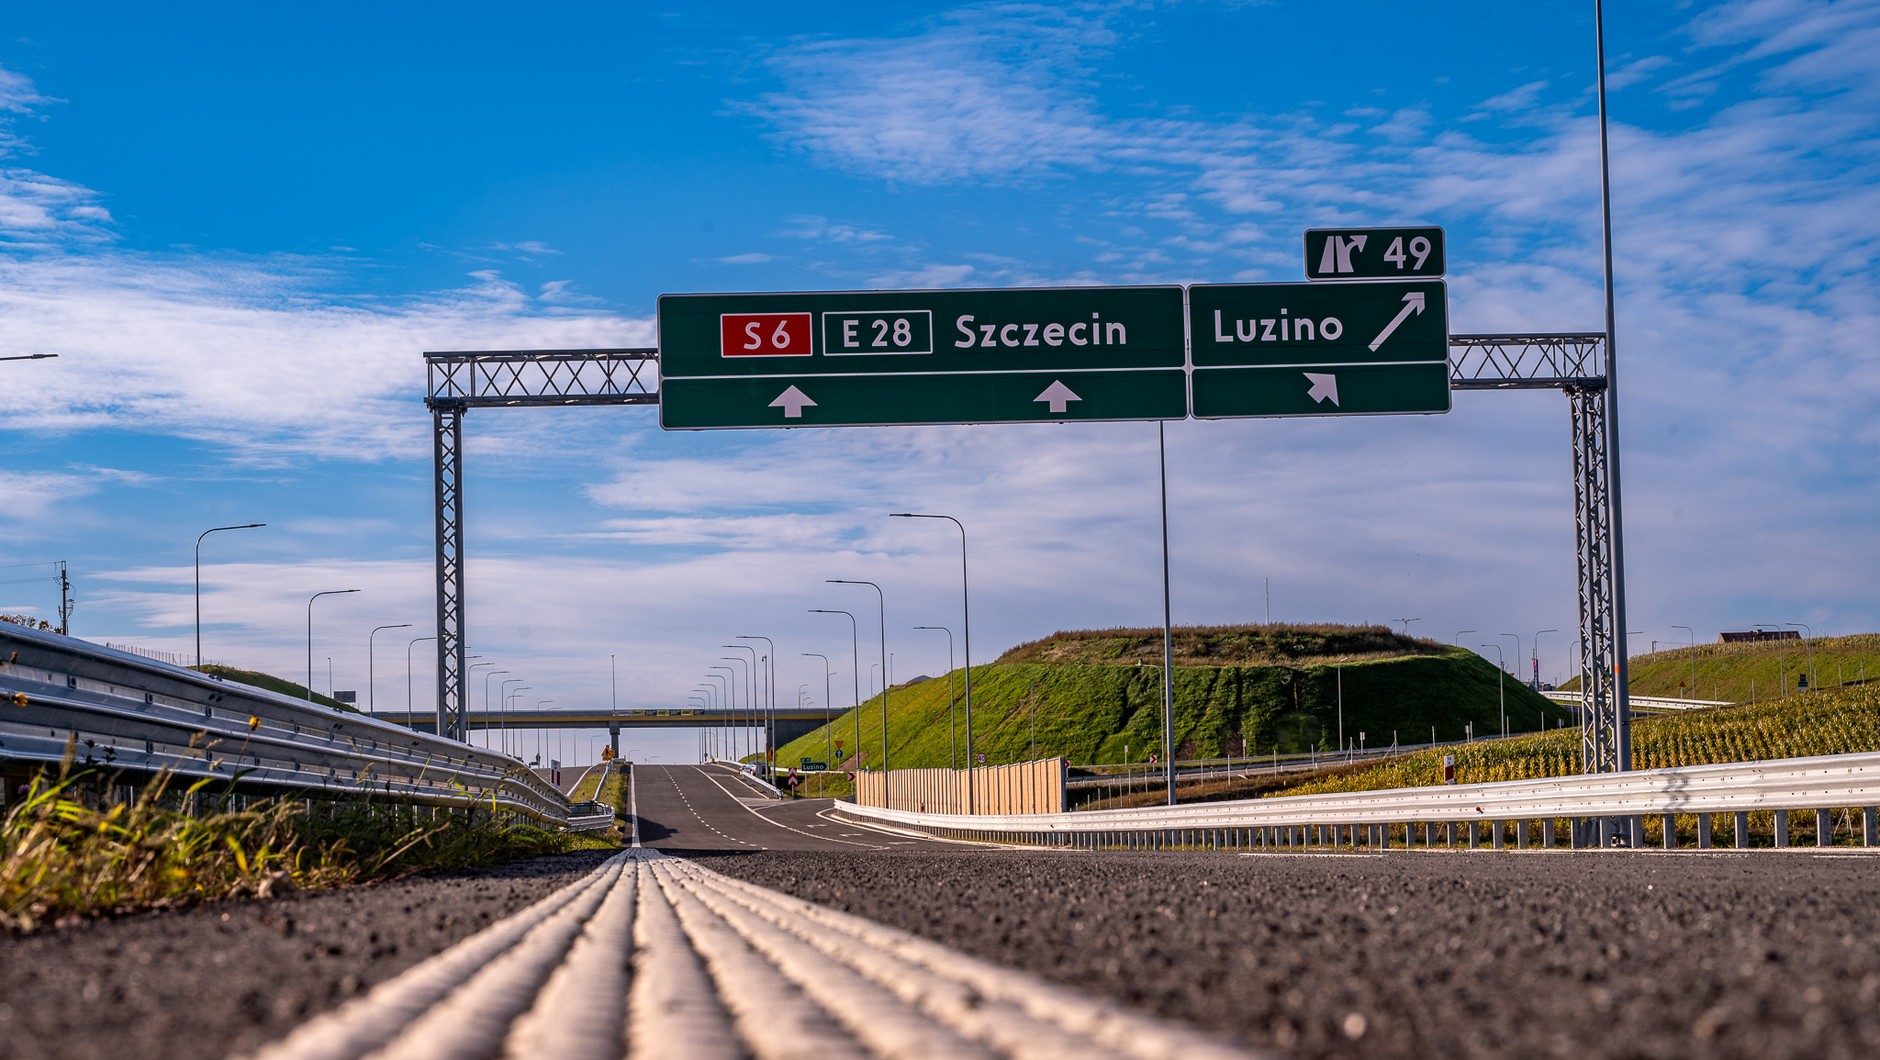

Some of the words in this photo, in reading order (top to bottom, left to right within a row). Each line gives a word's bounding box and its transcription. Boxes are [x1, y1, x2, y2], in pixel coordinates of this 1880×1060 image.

[1383, 236, 1431, 270] 49
[743, 321, 762, 350] S
[771, 320, 791, 349] 6
[843, 319, 860, 348] E
[871, 318, 912, 347] 28
[954, 312, 1127, 350] Szczecin
[1214, 308, 1343, 343] Luzino
